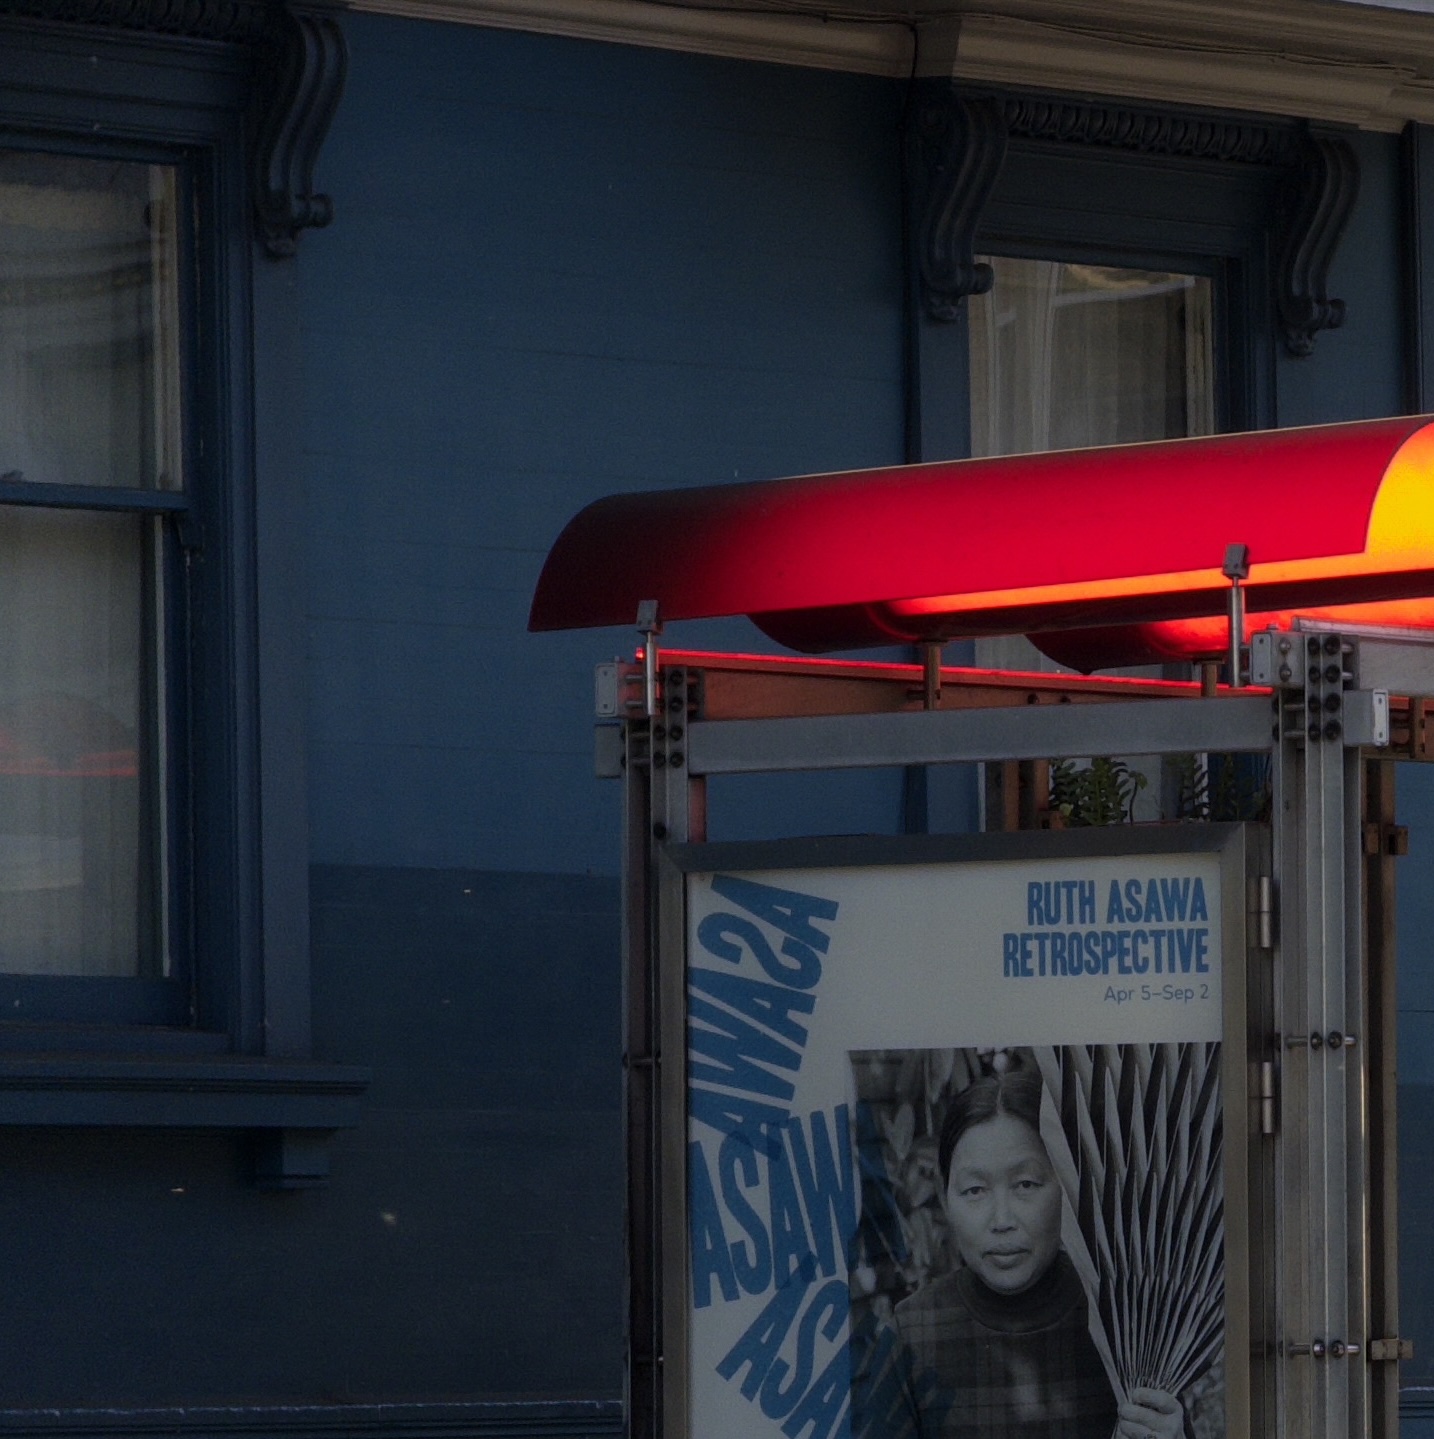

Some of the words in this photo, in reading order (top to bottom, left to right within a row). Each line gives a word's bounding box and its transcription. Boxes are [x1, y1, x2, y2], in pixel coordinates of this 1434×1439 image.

[1027, 879, 1097, 926] RUTH
[1106, 876, 1209, 924] ASAWA
[1002, 927, 1210, 978] RETROSPECTIVE
[1103, 985, 1135, 1005] Apr
[1200, 983, 1210, 1000] 2
